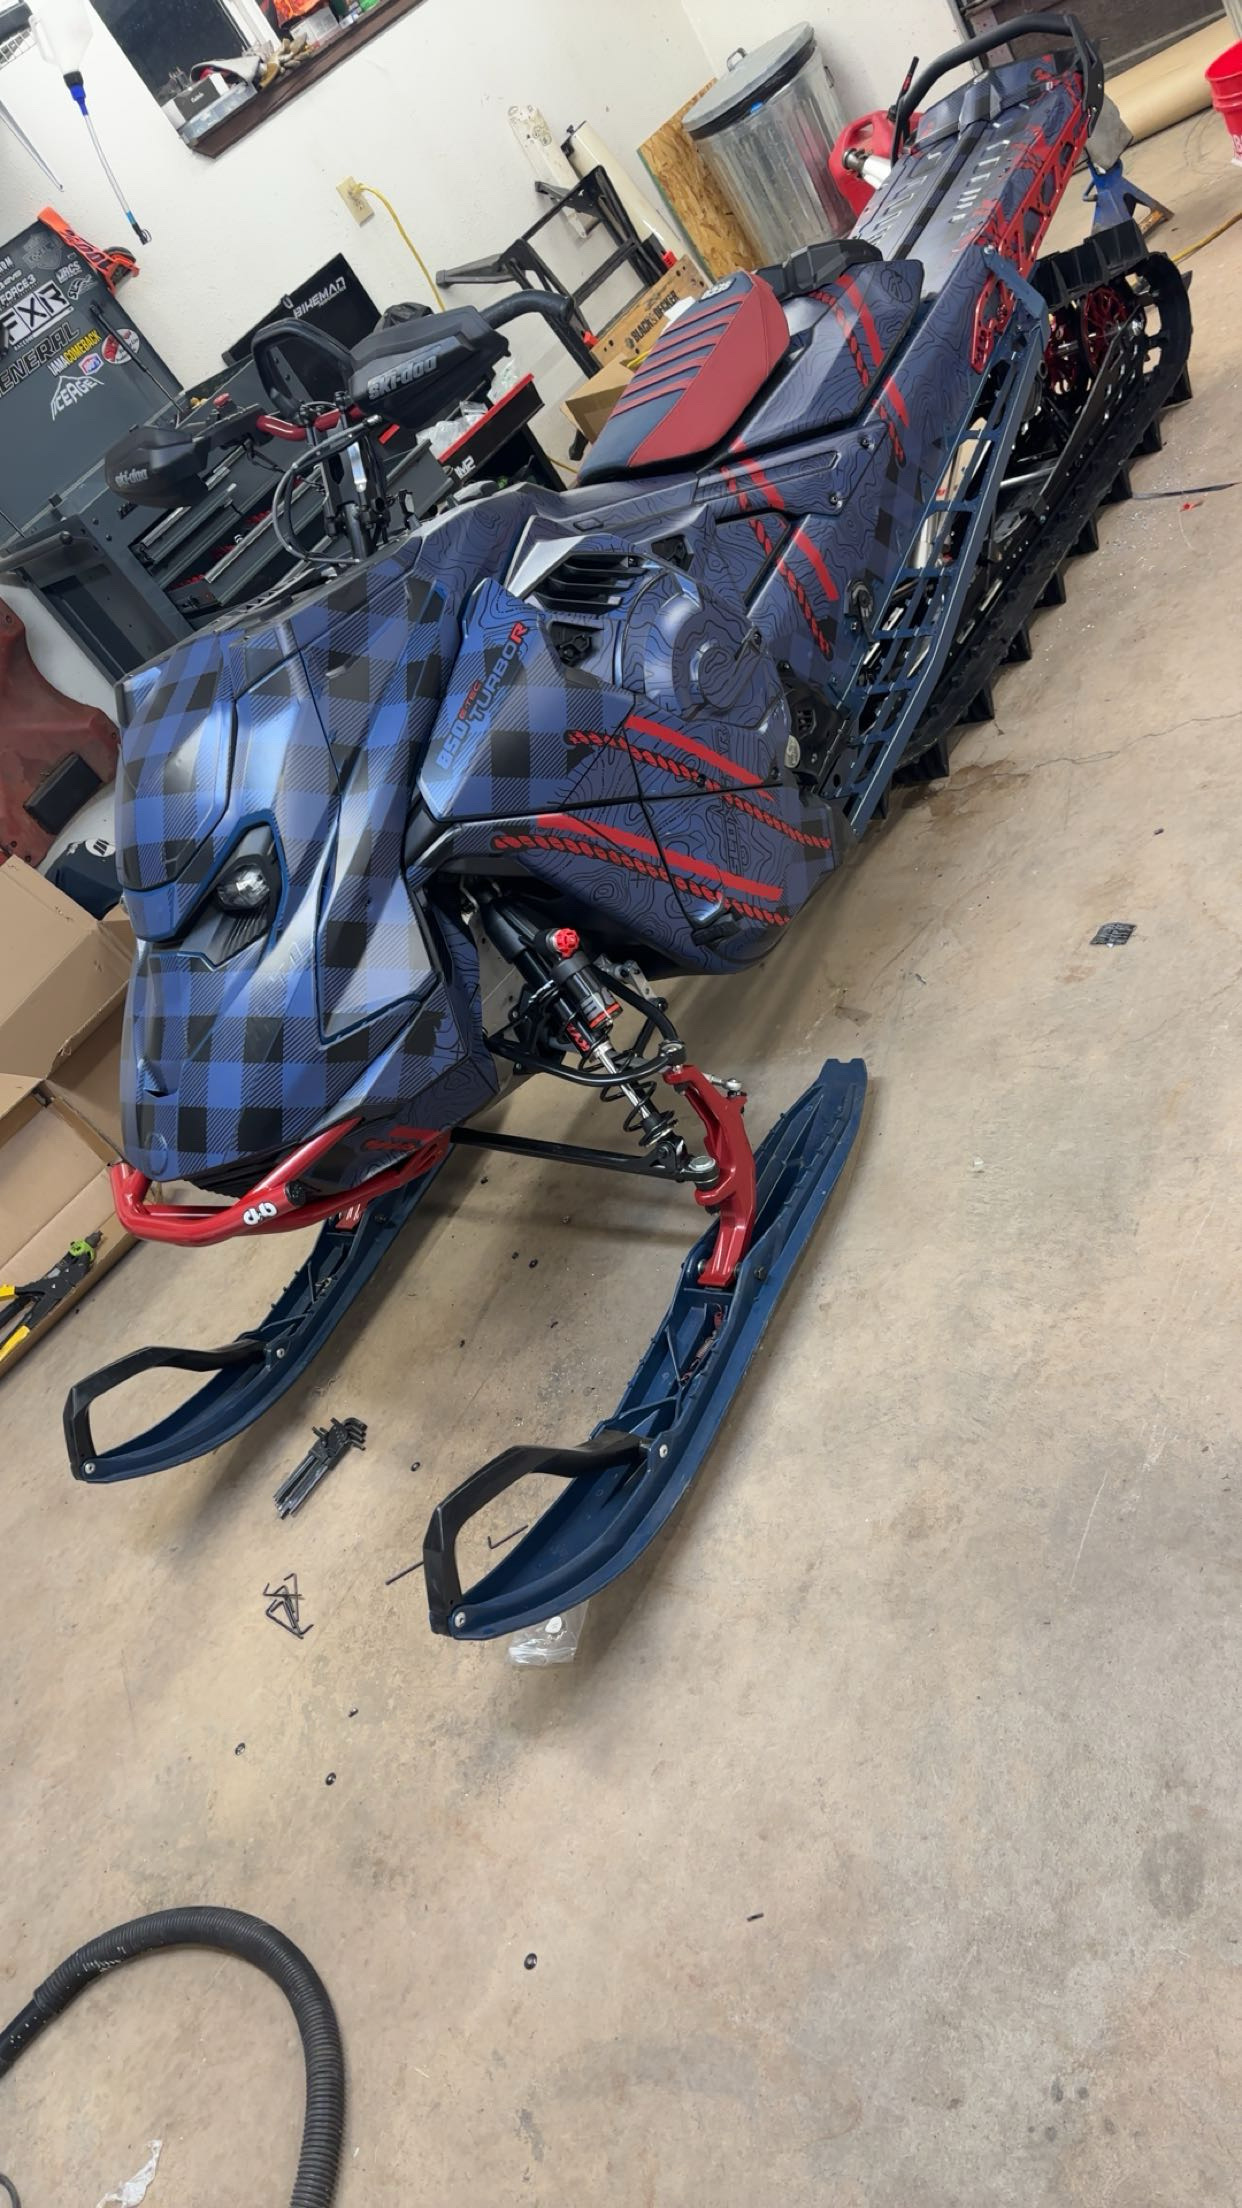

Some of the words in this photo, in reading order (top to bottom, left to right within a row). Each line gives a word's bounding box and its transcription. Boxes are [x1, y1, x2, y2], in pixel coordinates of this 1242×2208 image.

[0, 280, 70, 346] FXR
[630, 316, 655, 343] BLACK
[435, 718, 472, 770] 850
